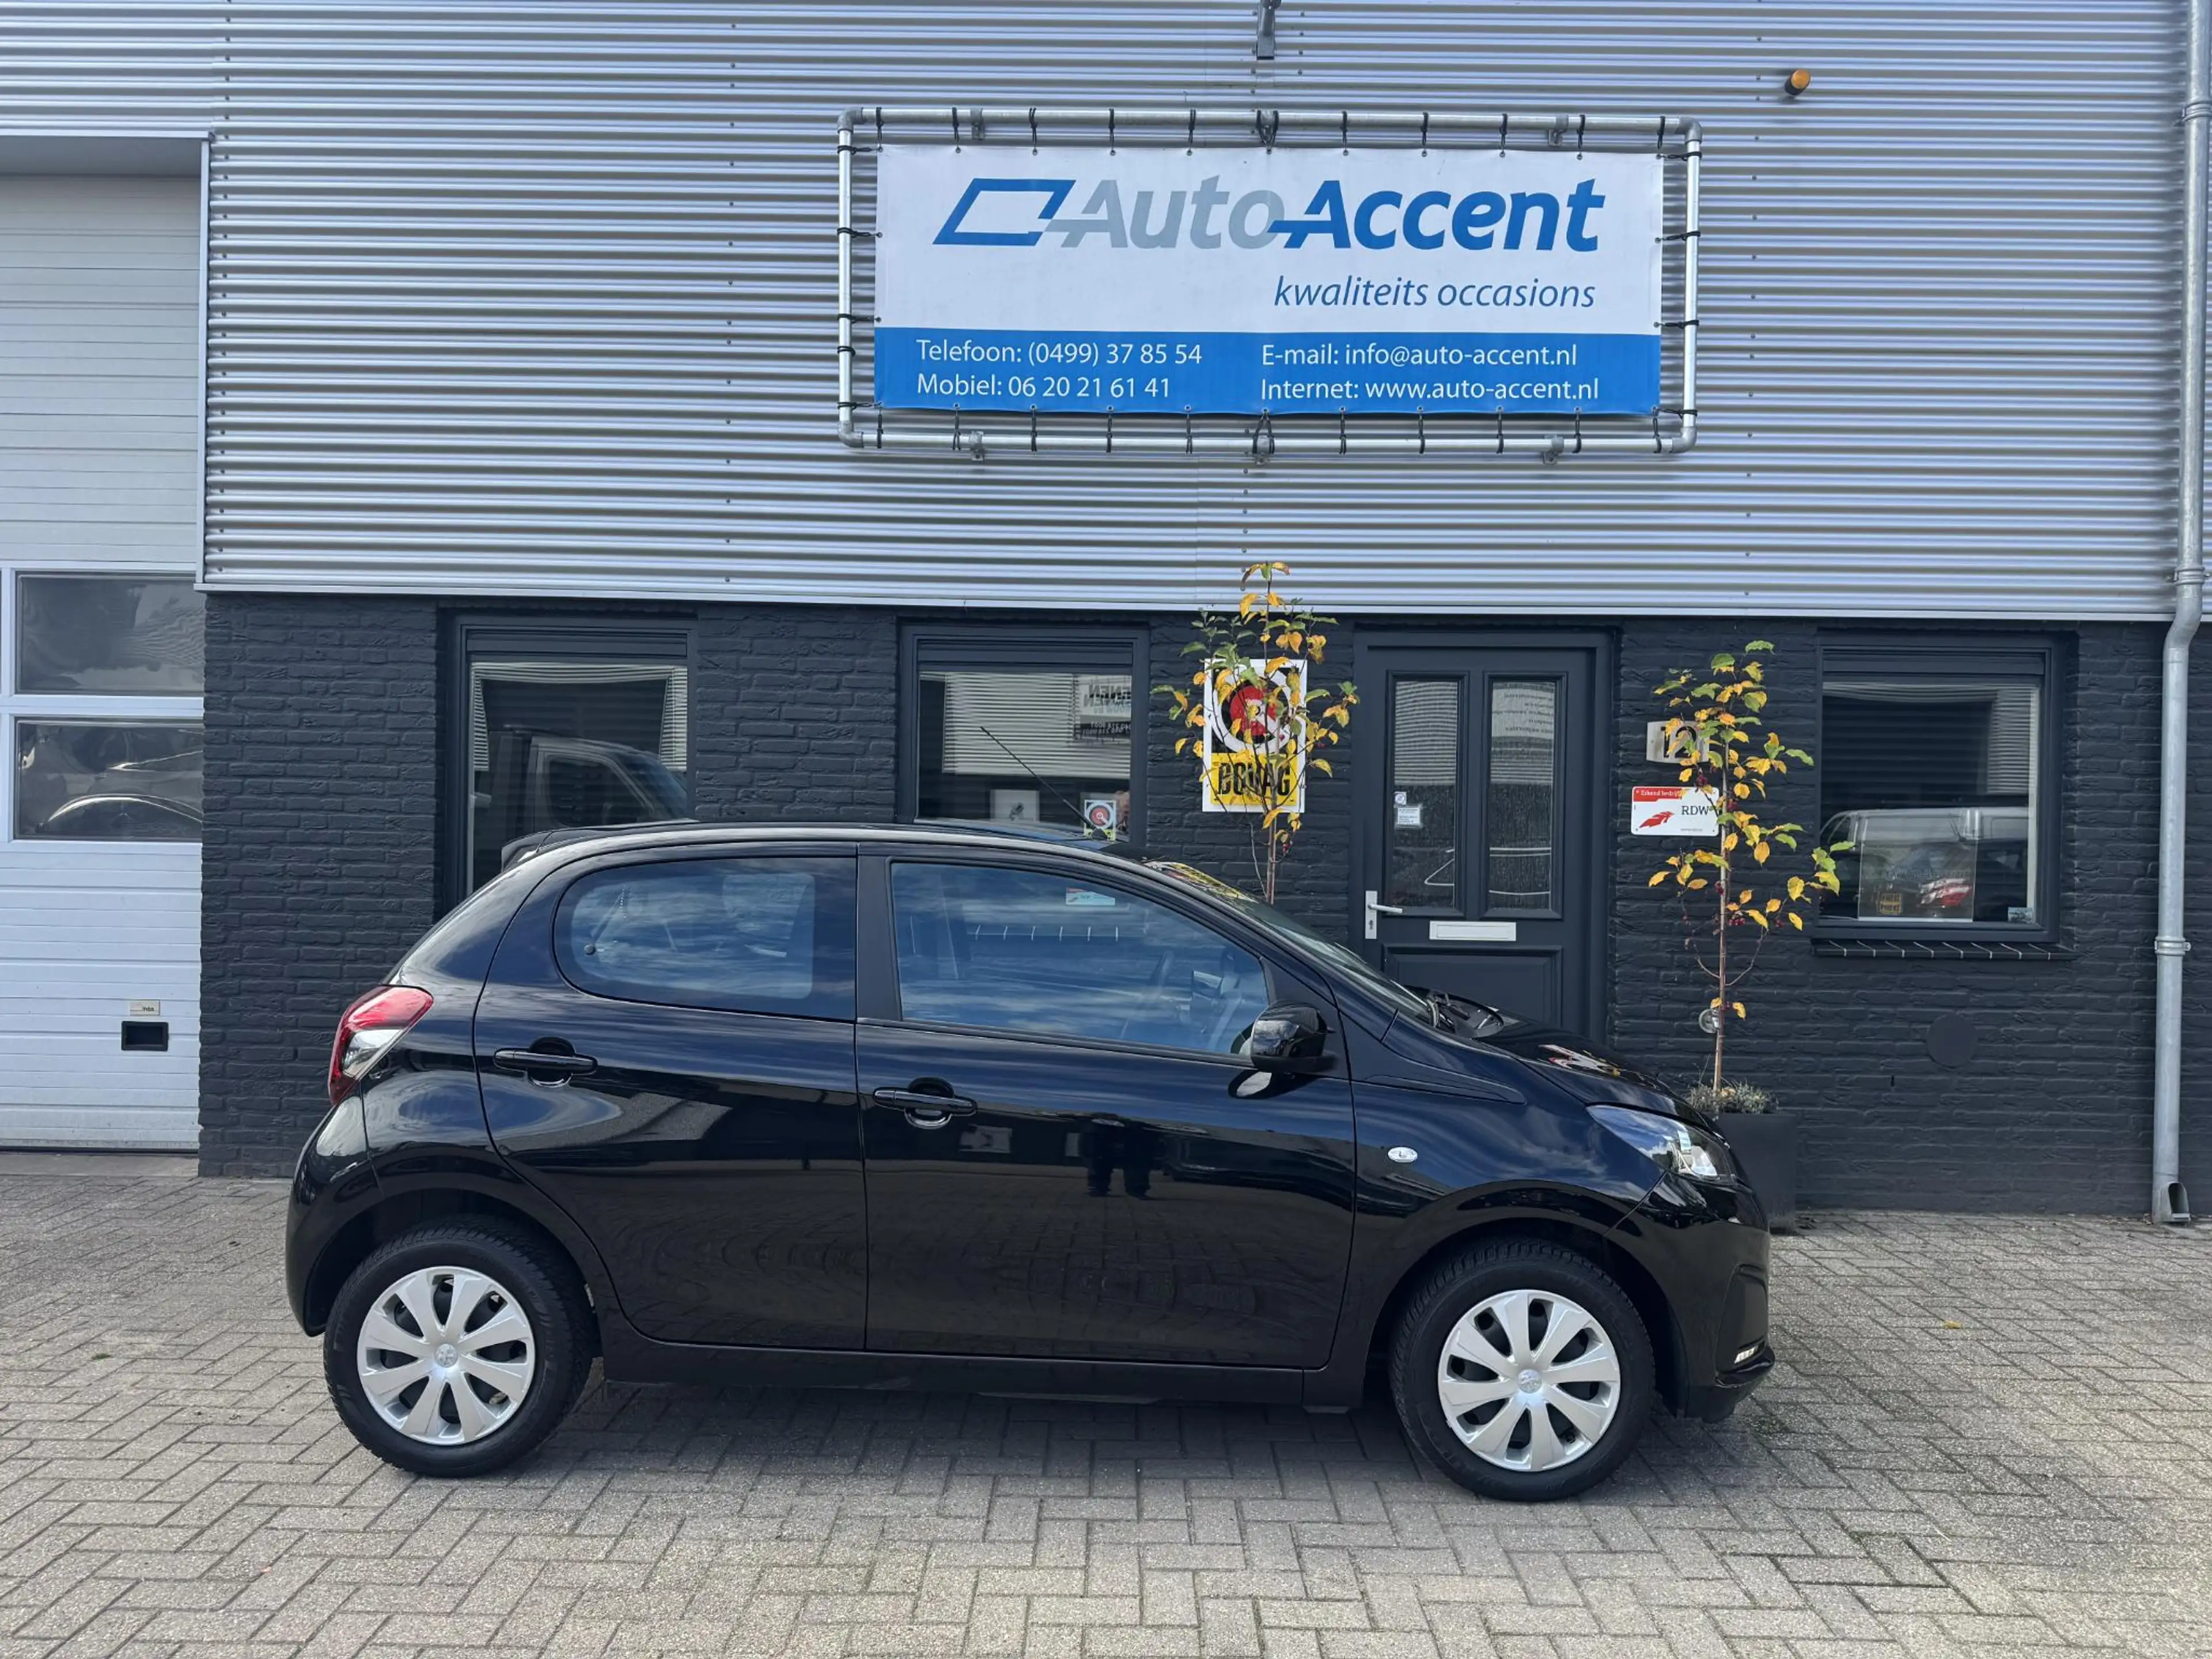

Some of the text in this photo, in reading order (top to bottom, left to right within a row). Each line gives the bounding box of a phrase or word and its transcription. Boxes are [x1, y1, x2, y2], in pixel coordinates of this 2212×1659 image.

[1274, 275, 1596, 308] kwaliteits occasions
[916, 339, 1202, 366] Telefoon: (0499) 37 85 54
[1262, 342, 1577, 367] E-mail: info@auto-accent.nl
[916, 373, 1169, 397] Mobiel: 06 20 21 61 41
[1261, 377, 1599, 400] Internet: www.auto-accent.nl
[1681, 805, 1709, 815] RDW
